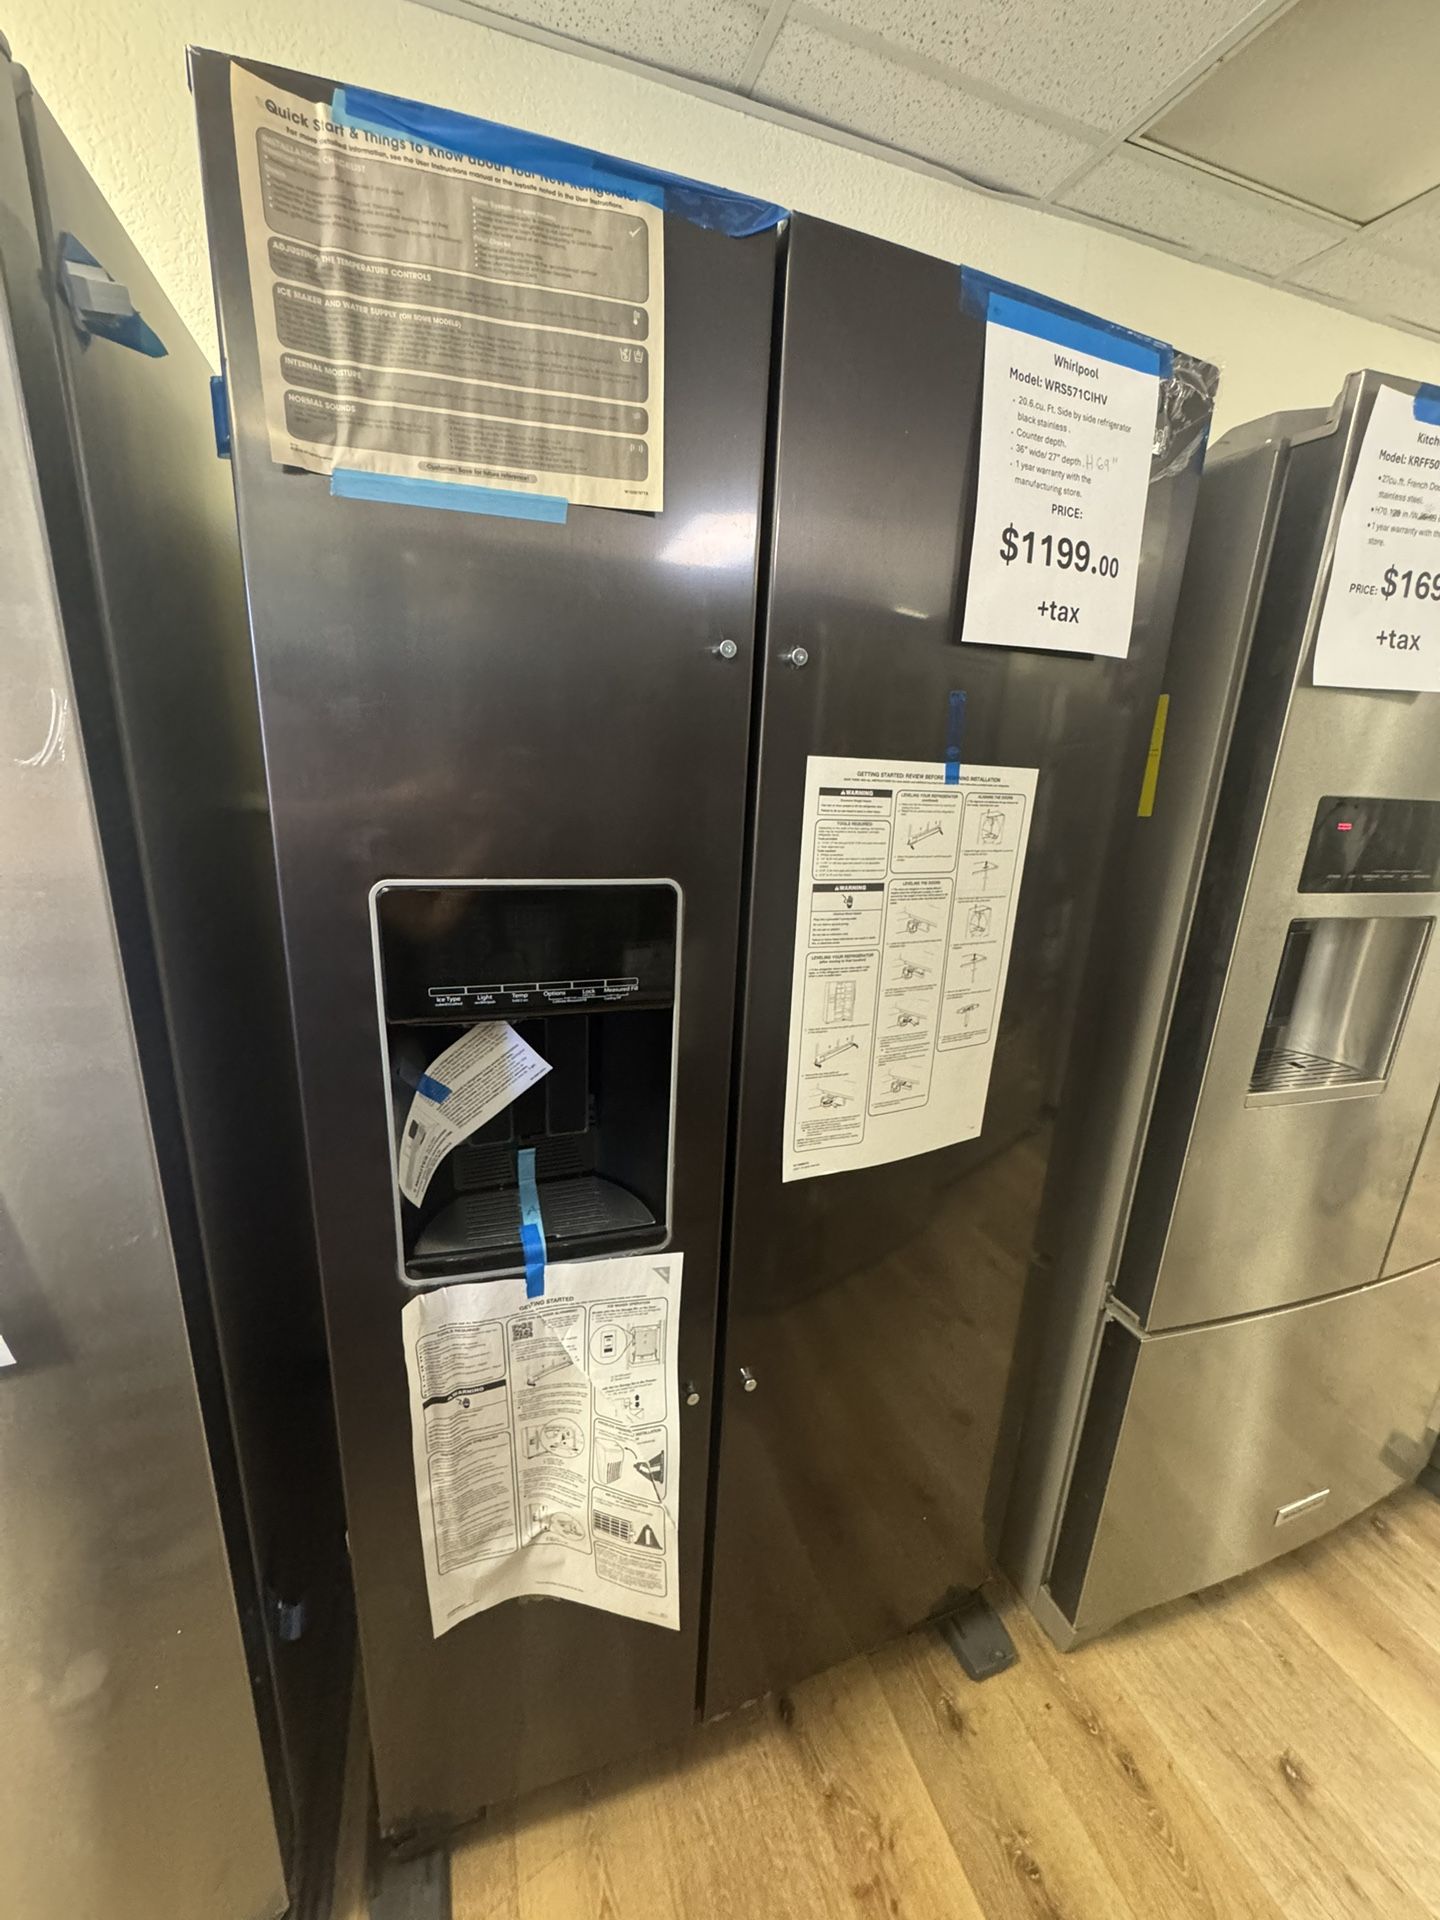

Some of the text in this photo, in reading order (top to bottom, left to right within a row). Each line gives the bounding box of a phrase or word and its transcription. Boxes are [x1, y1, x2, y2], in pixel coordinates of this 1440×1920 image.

[265, 99, 309, 128] Quick
[313, 119, 345, 138] Start
[350, 127, 359, 140] &
[363, 129, 406, 151] Things
[410, 140, 423, 154] to
[428, 145, 463, 163] Know
[390, 154, 401, 162] see
[403, 155, 414, 164] the
[415, 158, 430, 167] User
[431, 161, 468, 176] Instructions
[469, 170, 493, 182] manual
[502, 177, 513, 186] the
[514, 181, 538, 192] website
[538, 185, 557, 197] noted
[557, 189, 563, 198] in
[564, 191, 575, 200] the
[575, 193, 589, 203] User
[589, 195, 624, 210] Instructions.
[272, 240, 432, 282] ADJUSTING THE TEMPERATURE CONTROLS
[277, 286, 292, 298] ICE
[293, 290, 322, 306] MAKER
[324, 295, 342, 308] AND
[342, 300, 369, 315] WATER
[370, 306, 397, 319] SUPPLY
[284, 357, 362, 379] INTERNAL MOISTURE
[1053, 353, 1099, 380] Whirlpool
[1009, 367, 1108, 406] Model: WRS571CIHV
[288, 393, 356, 413] NORMAL SOUNDS
[1017, 411, 1037, 425] black
[1047, 403, 1056, 414] Ft.
[1057, 406, 1073, 418] Side
[1073, 410, 1082, 422] by
[1082, 413, 1096, 424] side
[1097, 416, 1132, 433] refrigerator
[1016, 427, 1067, 449] Counter depth.
[1417, 432, 1440, 447] Kitch
[1379, 448, 1440, 471] Model: KRFF50
[1016, 459, 1092, 485] 1 year warranty with the
[1014, 476, 1083, 498] manufacturing store.
[1051, 503, 1083, 520] PRICE:
[1349, 582, 1378, 596] PRICE:
[1037, 600, 1080, 624] +tax
[1376, 629, 1421, 651] +tax
[857, 770, 880, 778] GETTING
[905, 772, 924, 780] REVIEW
[925, 773, 944, 781] BEFORE
[446, 995, 462, 1003] Type
[477, 994, 493, 1002] Light
[519, 1296, 575, 1311] GETTING STARTED
